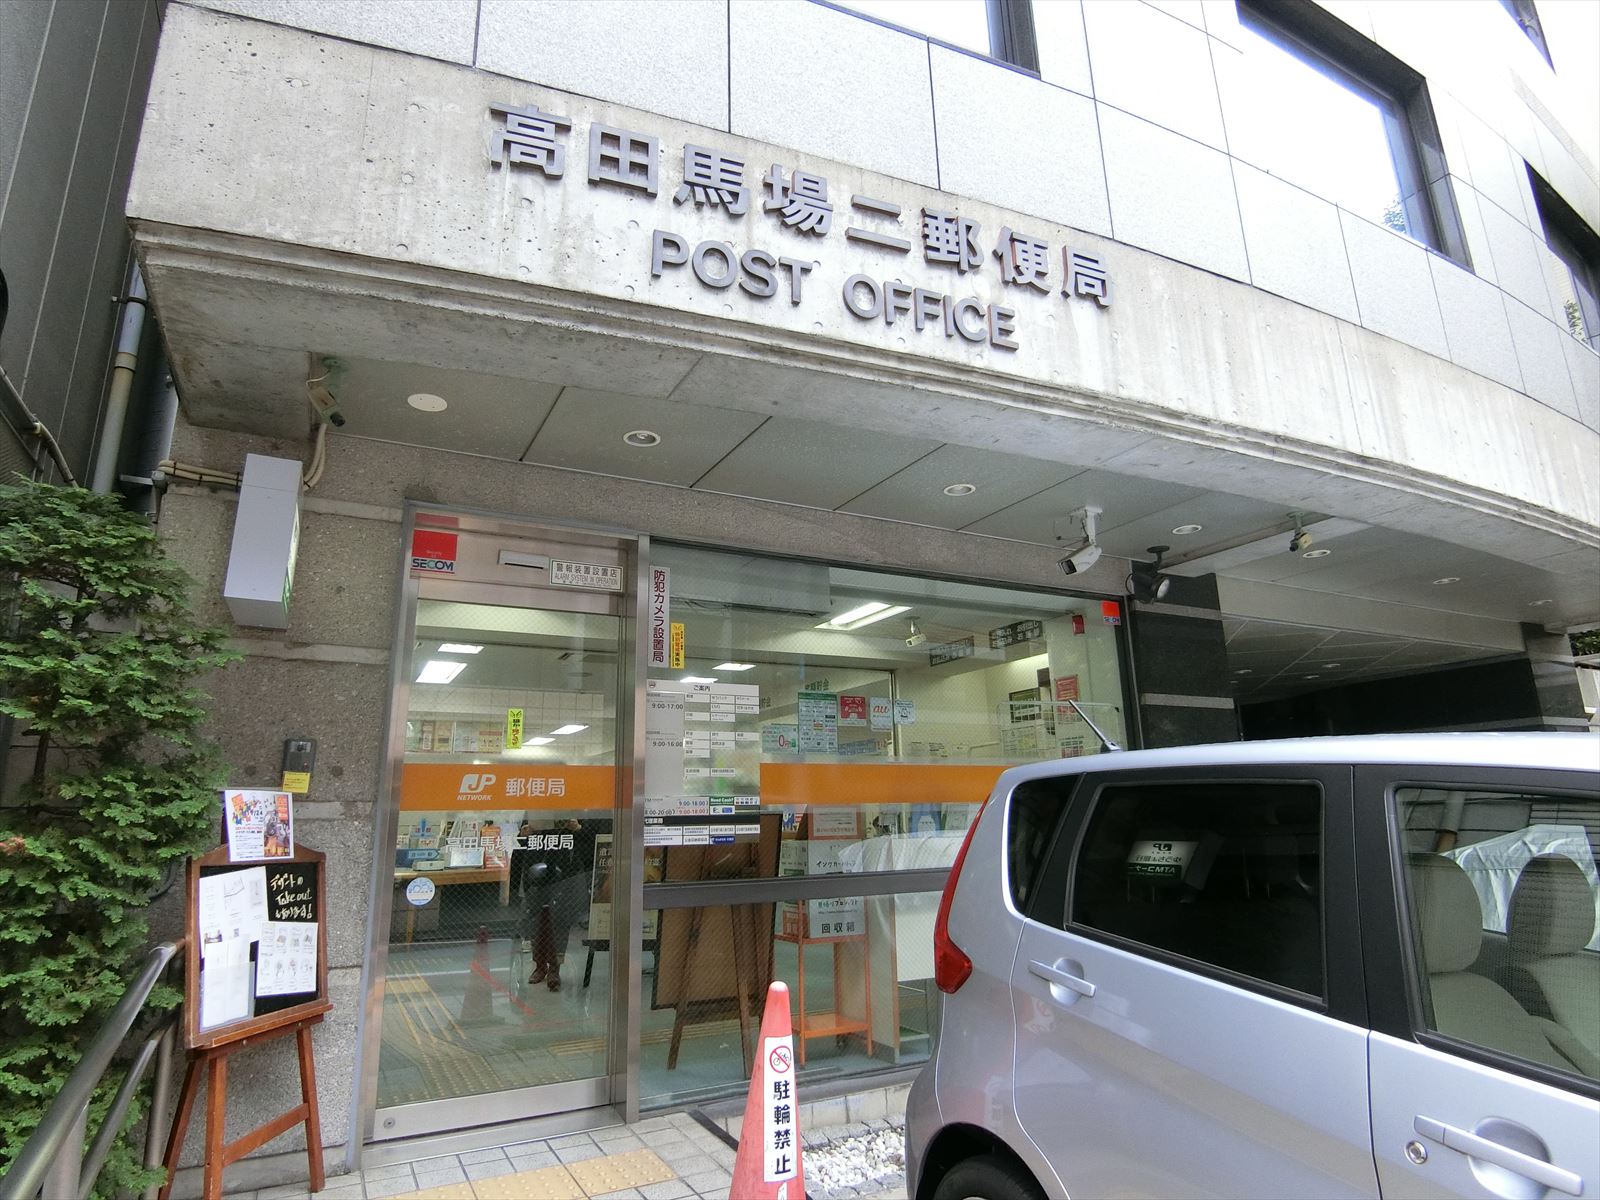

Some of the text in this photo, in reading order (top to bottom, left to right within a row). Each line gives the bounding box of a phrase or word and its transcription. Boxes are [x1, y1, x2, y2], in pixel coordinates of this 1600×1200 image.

[489, 102, 1115, 308] 高田馬場二郵便局
[651, 229, 1020, 350] POST OFFICE
[412, 558, 454, 571] SECOM
[556, 562, 619, 578] 警報装置設置店
[652, 569, 666, 663] 防犯カメラ設置局
[651, 702, 684, 710] 9:00-17:00
[873, 705, 890, 714] au
[505, 777, 566, 797] 郵便局
[445, 834, 574, 851] 高田馬場二郵便局
[275, 888, 312, 906] Take out
[821, 922, 855, 933] 回収箱
[773, 1080, 791, 1175] 駐輪禁止
